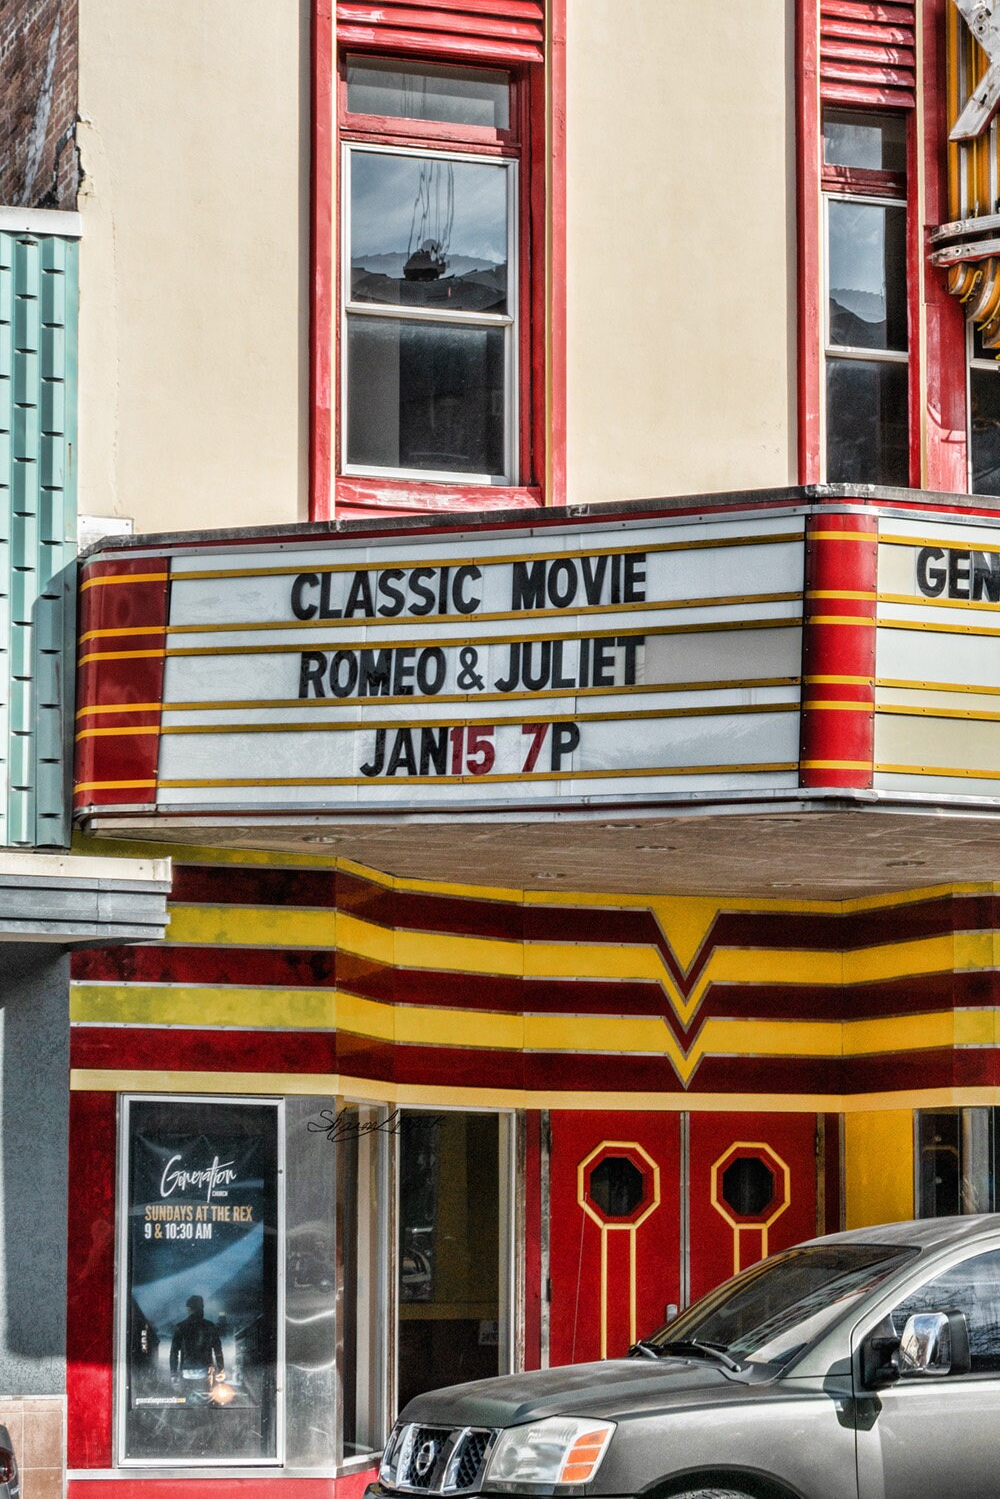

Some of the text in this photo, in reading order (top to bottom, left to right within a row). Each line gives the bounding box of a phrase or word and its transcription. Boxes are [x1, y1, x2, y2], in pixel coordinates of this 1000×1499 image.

[291, 553, 647, 621] CLASSIC MOVIE
[299, 634, 646, 699] ROMEO & JULIET
[160, 1154, 237, 1203] Generation
[144, 1222, 212, 1239] 9 & 10:30 AM
[145, 1205, 253, 1221] SUNDAYS AT THE REX
